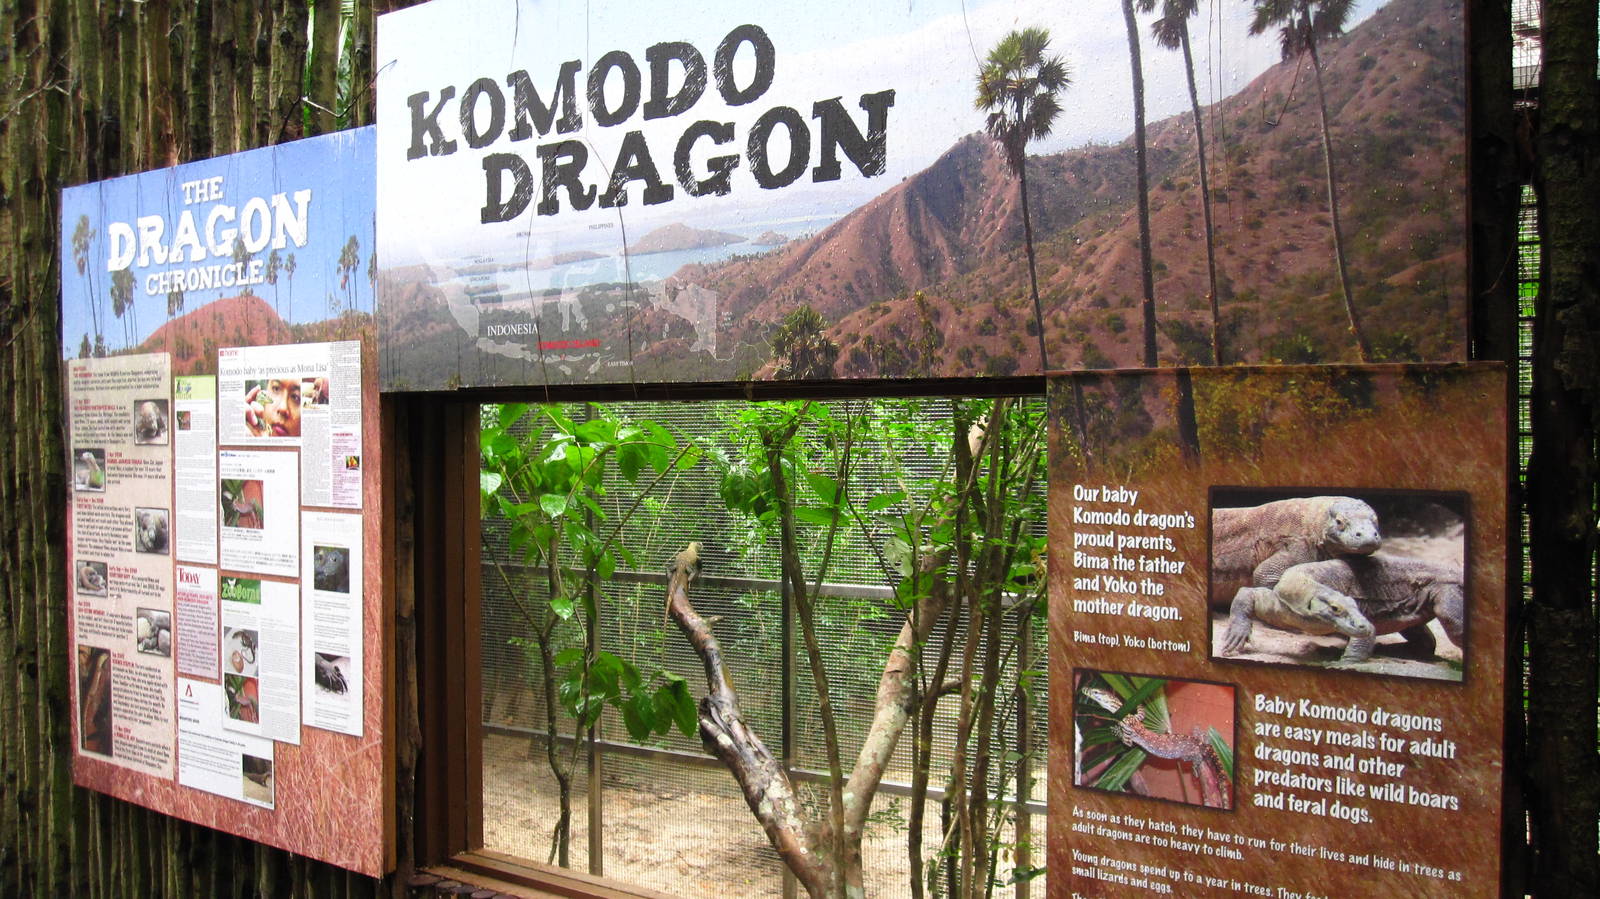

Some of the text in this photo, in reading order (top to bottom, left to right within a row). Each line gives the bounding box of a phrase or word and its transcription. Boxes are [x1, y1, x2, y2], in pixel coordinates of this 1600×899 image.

[406, 23, 776, 161] KOMODO
[480, 88, 897, 224] DRAGON
[181, 175, 225, 205] THE
[107, 188, 312, 272] DRAGON
[145, 259, 264, 296] CHRONICLE
[487, 323, 539, 337] INDONESIA
[1073, 484, 1138, 506] Our baby
[1073, 506, 1195, 530] Komodo dragon's
[1073, 531, 1177, 553] proud parents,
[1073, 551, 1185, 574] Bima the father
[1073, 575, 1164, 596] and Yoko the
[1073, 597, 1183, 622] mother dragon.
[1073, 630, 1096, 643] Bima
[1123, 634, 1146, 648] Yoko
[1147, 637, 1191, 652] (bottom)
[1255, 693, 1442, 732] Baby Komodo dragons
[1255, 722, 1456, 759] are easy meals for adult
[1254, 741, 1405, 778] dragons and other
[1254, 768, 1459, 811] predators like wild boars
[1253, 792, 1373, 825] and feral dogs.
[1072, 822, 1245, 861] adult dragons are too heavy to climb.
[1072, 805, 1084, 818] As
[1086, 809, 1107, 822] soon
[1110, 814, 1121, 824] as
[1123, 814, 1146, 830] they
[1180, 824, 1204, 839] they
[1207, 827, 1231, 843] have
[1234, 833, 1245, 845] to
[1248, 837, 1266, 849] run
[1269, 838, 1287, 852] for
[1290, 842, 1317, 857] their
[1320, 846, 1345, 862] lives
[1348, 853, 1369, 866] and
[1373, 854, 1395, 871] hide
[1398, 860, 1410, 873] in
[1414, 863, 1444, 879] trees
[1447, 870, 1462, 882] as
[1071, 866, 1174, 894] small lizards and eggs.
[1072, 848, 1099, 866] Young
[1100, 855, 1137, 872] dragons
[1140, 864, 1167, 877] spend
[1169, 870, 1181, 881] up
[1183, 870, 1194, 882] to
[1196, 874, 1203, 884] a
[1205, 876, 1228, 889] year
[1231, 878, 1241, 891] in
[1244, 882, 1274, 897] trees.
